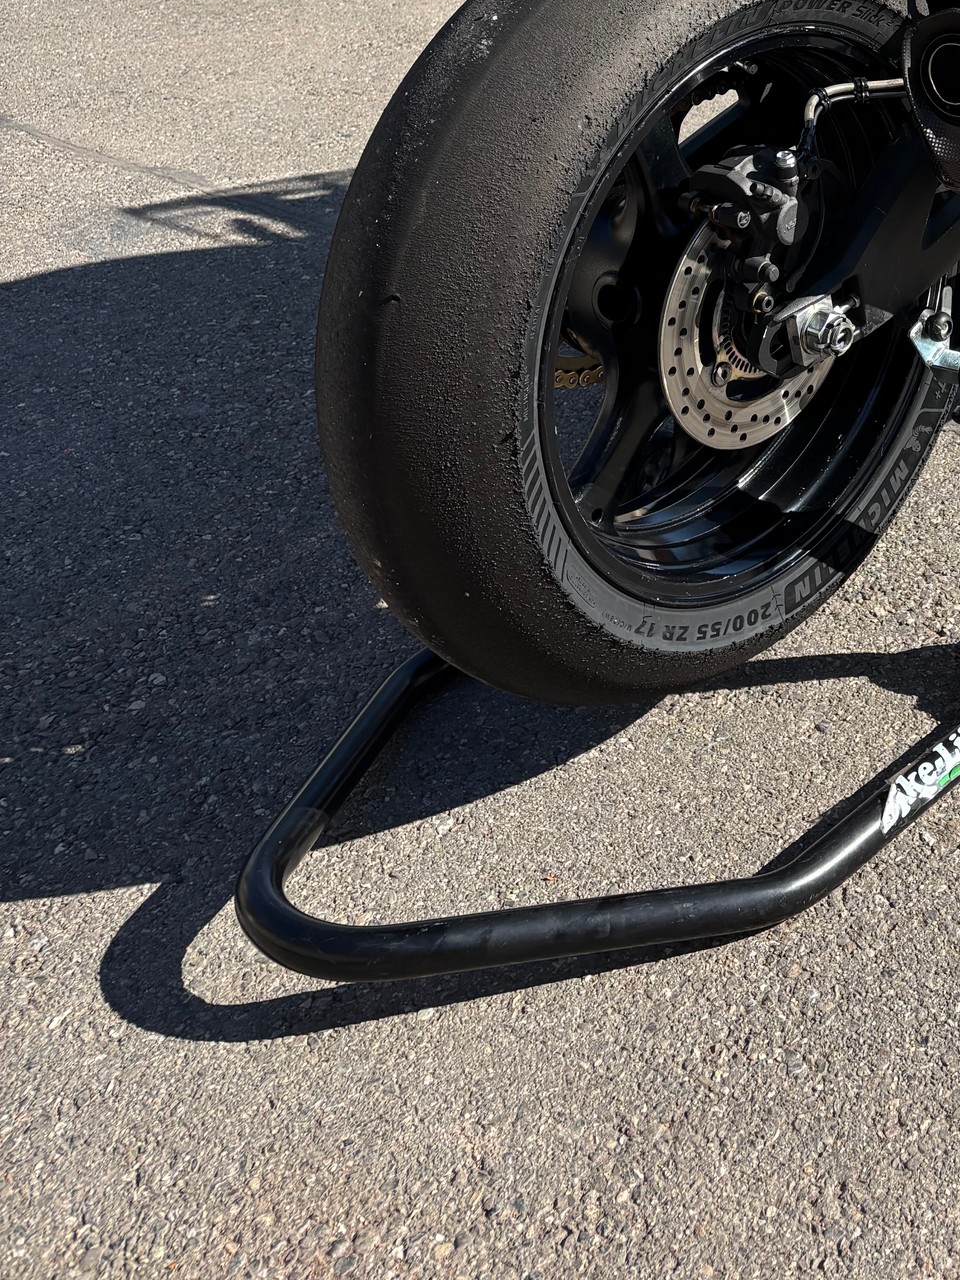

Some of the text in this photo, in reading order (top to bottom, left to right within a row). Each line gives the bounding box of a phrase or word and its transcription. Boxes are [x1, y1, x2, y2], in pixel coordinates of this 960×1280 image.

[634, 616, 656, 637] 17
[696, 601, 772, 641] 200/55
[662, 624, 689, 642] ZR
